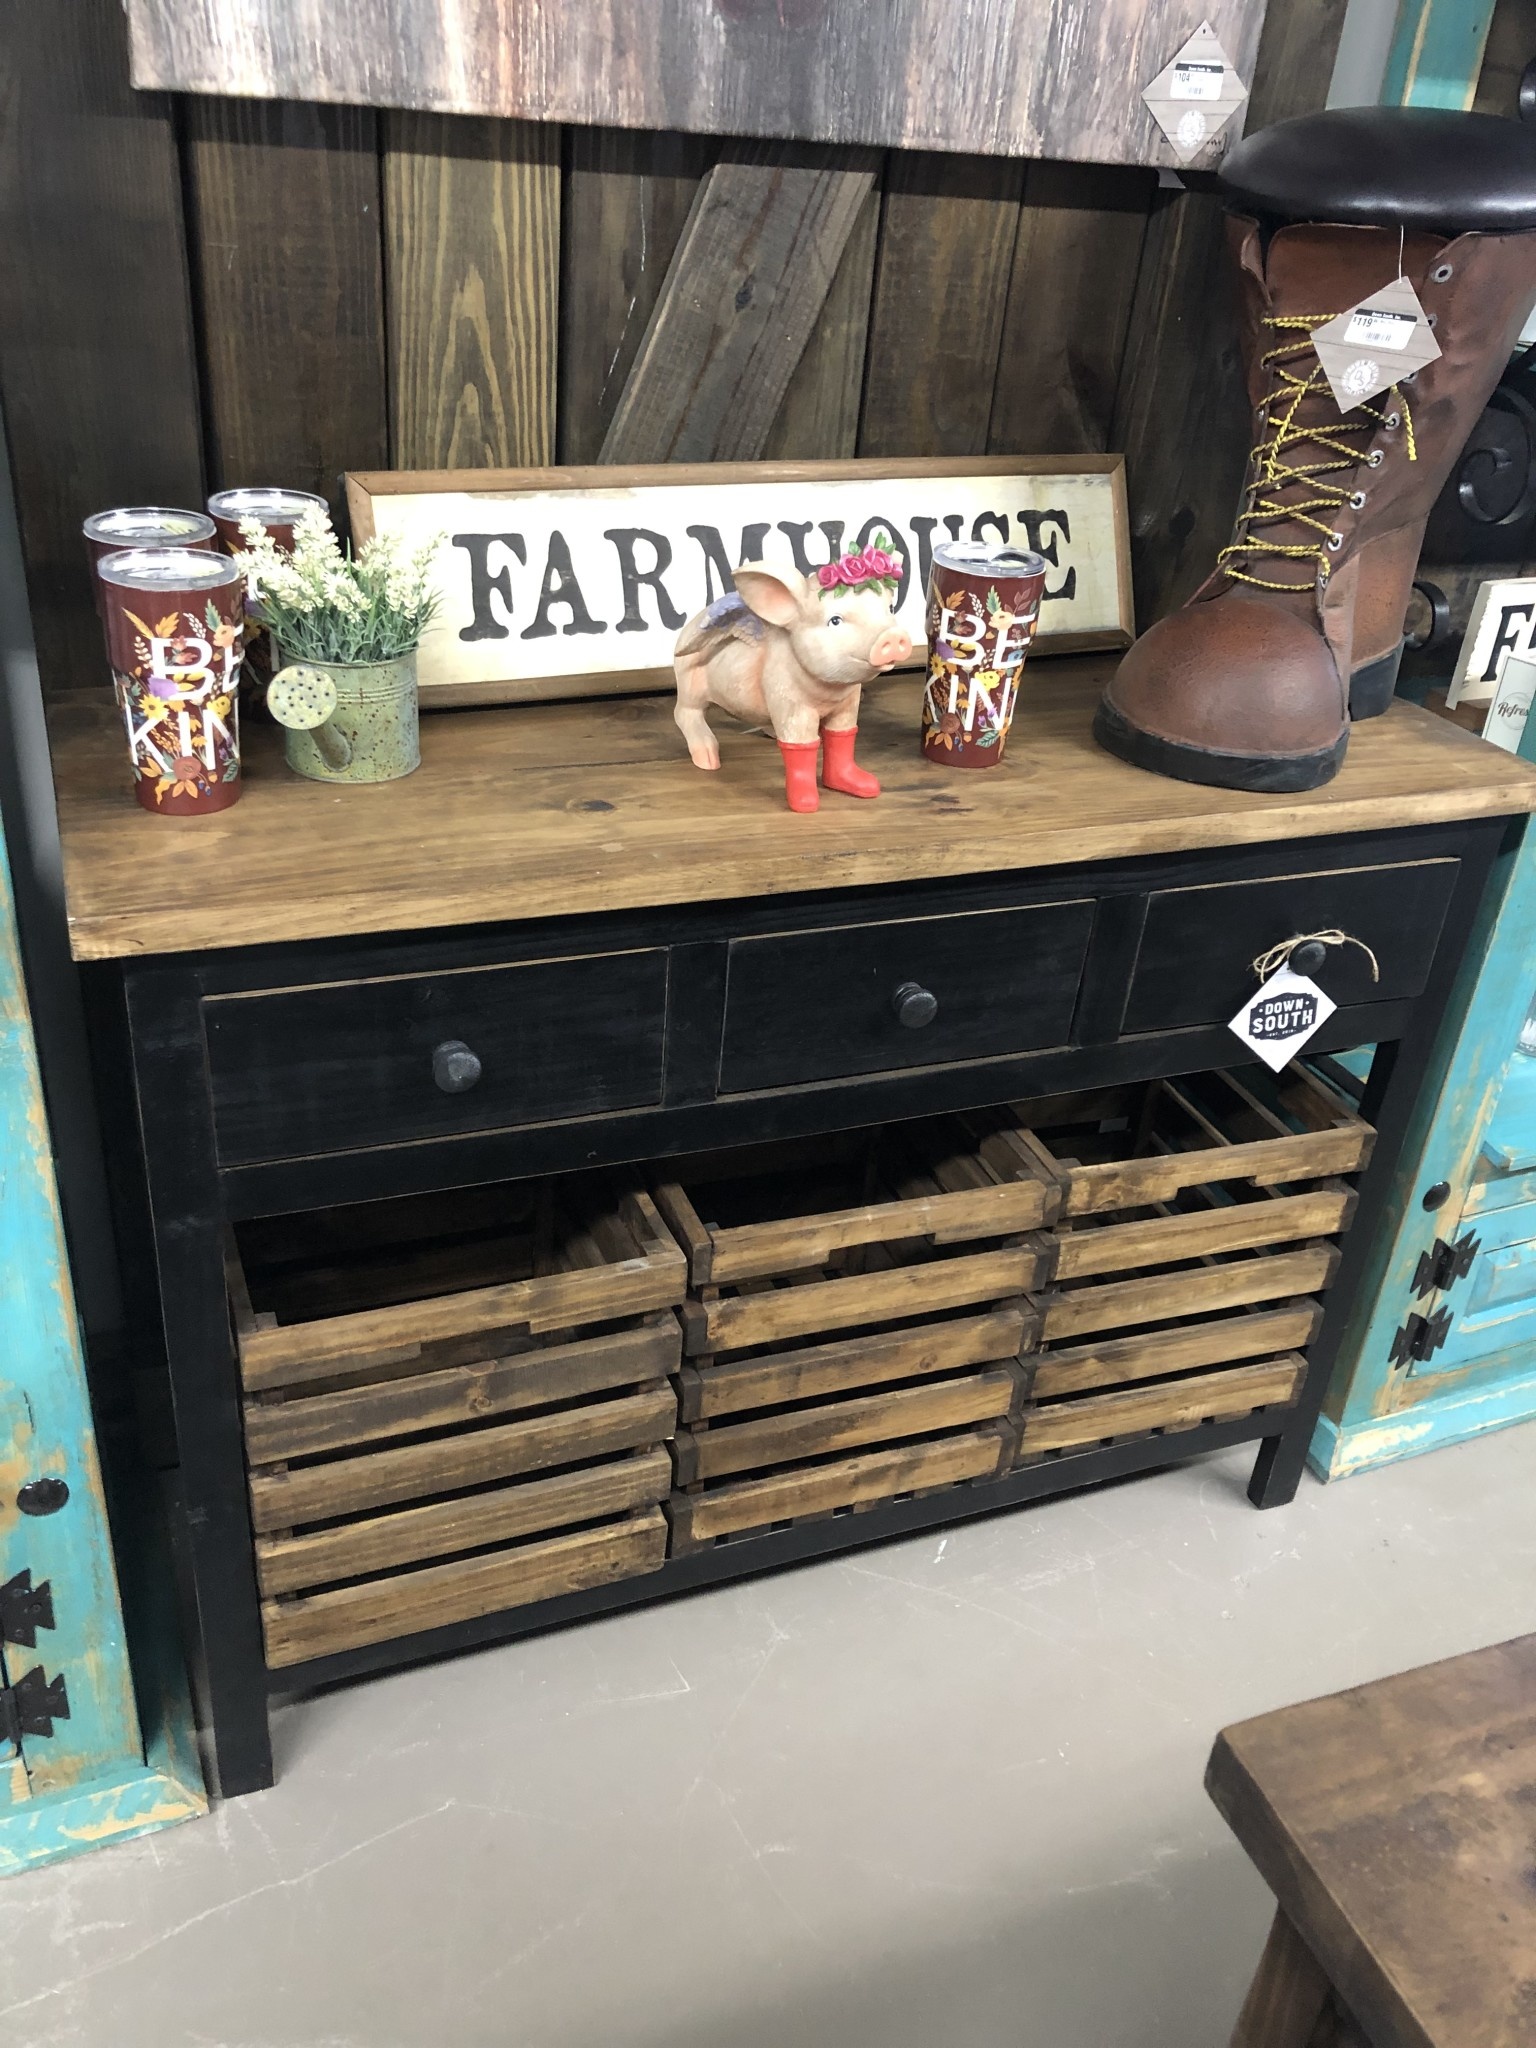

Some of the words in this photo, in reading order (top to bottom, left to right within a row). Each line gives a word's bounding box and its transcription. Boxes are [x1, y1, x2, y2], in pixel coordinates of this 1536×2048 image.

[150, 623, 245, 701] BE
[938, 607, 1036, 670] BE
[1480, 603, 1536, 682] F
[1252, 1009, 1313, 1034] SOUTH
[1264, 998, 1304, 1015] DOWN
